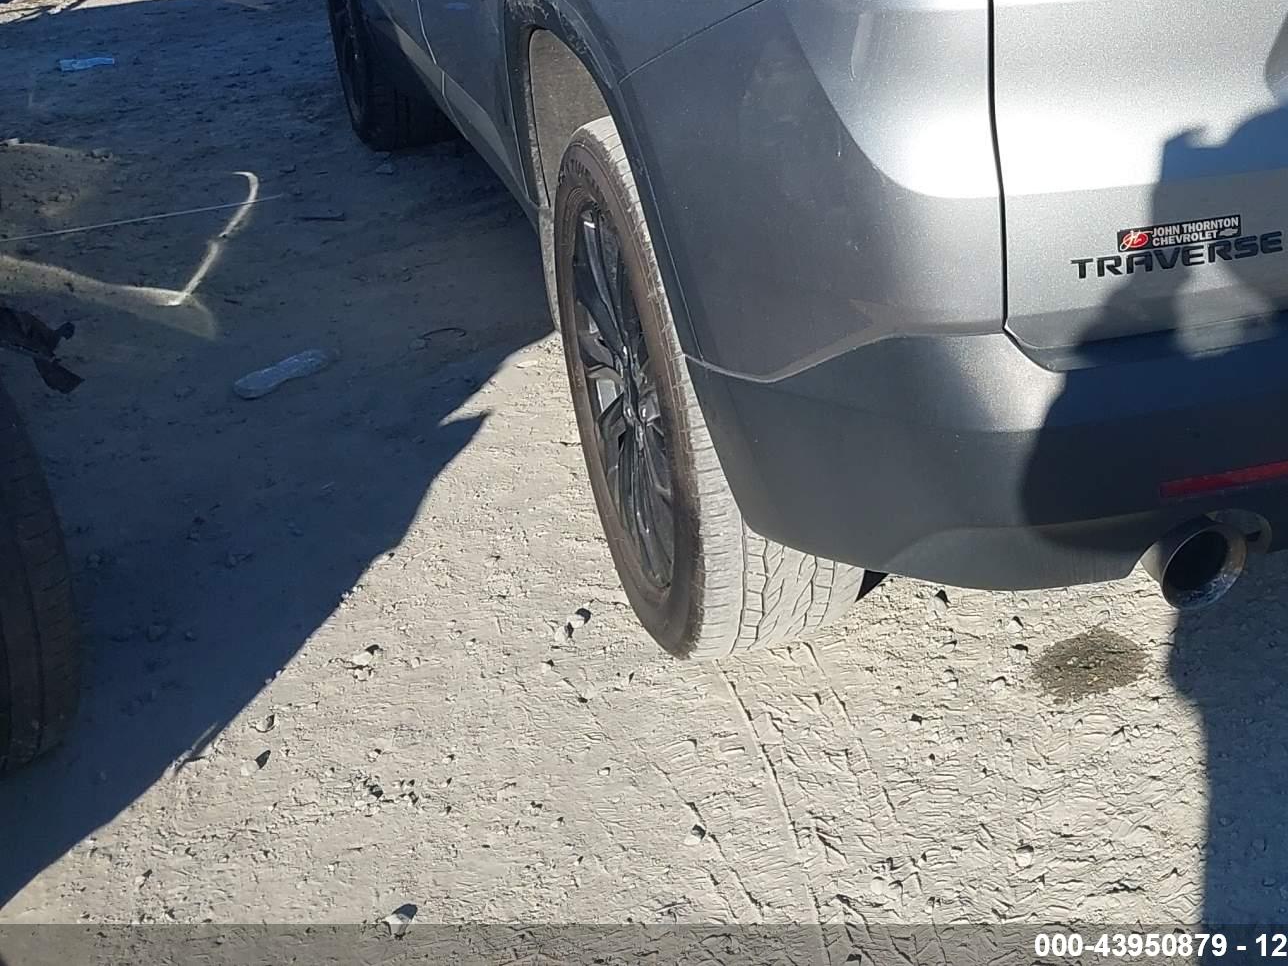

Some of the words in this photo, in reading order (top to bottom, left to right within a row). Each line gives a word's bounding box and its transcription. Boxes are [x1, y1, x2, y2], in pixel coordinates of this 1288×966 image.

[1152, 223, 1181, 238] JOHN
[1182, 216, 1239, 234] THORNTON
[1152, 229, 1219, 247] CHEVROLET
[1070, 231, 1283, 279] TRAVERSE
